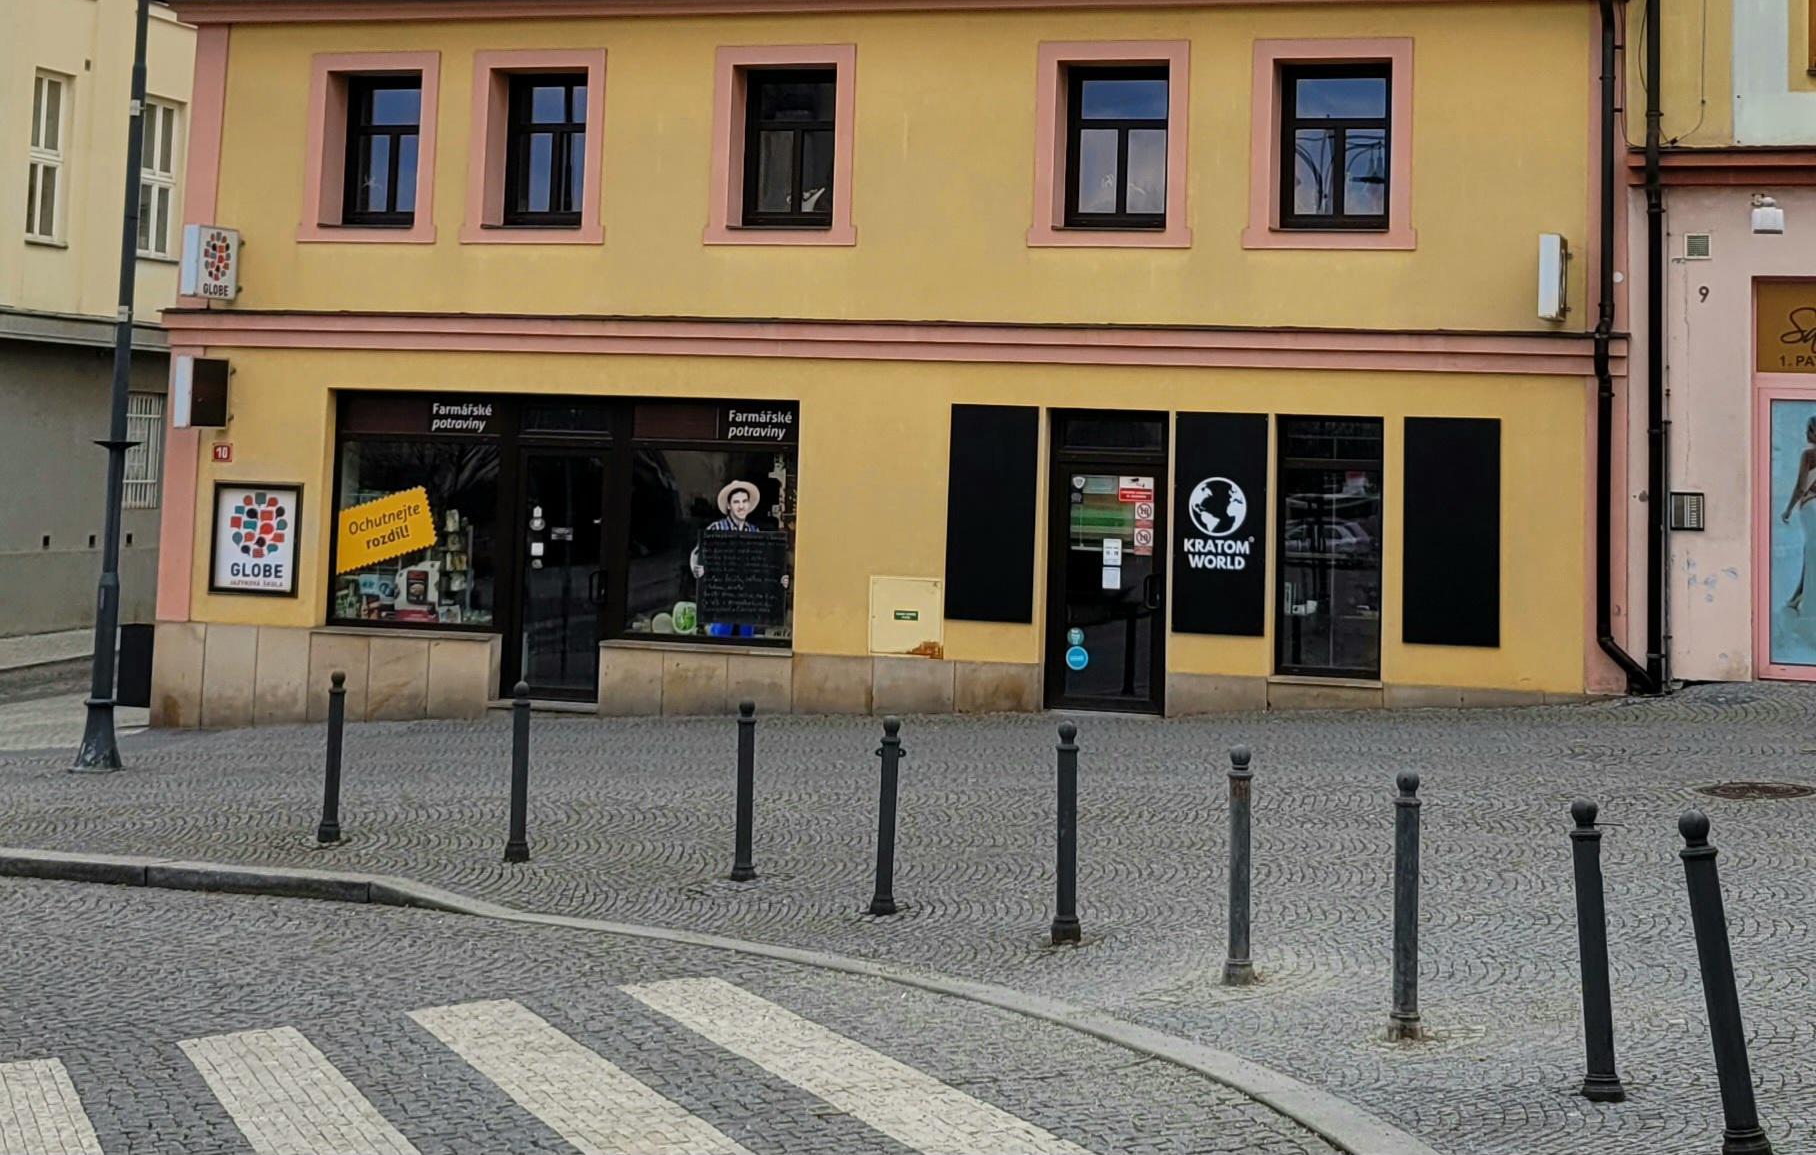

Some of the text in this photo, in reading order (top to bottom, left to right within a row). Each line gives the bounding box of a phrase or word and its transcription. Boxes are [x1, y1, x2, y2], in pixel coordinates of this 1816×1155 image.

[203, 283, 229, 297] GLOBE
[1699, 286, 1710, 303] 9
[1796, 355, 1816, 367] PA
[433, 403, 492, 416] Farmářské
[729, 410, 792, 423] Farmářské
[431, 417, 486, 433] potraviny
[728, 425, 786, 441] potraviny
[216, 446, 228, 459] 10
[348, 504, 420, 535] Ochutnejte
[1188, 553, 1246, 570] WORLD
[230, 562, 283, 578] GLOBE
